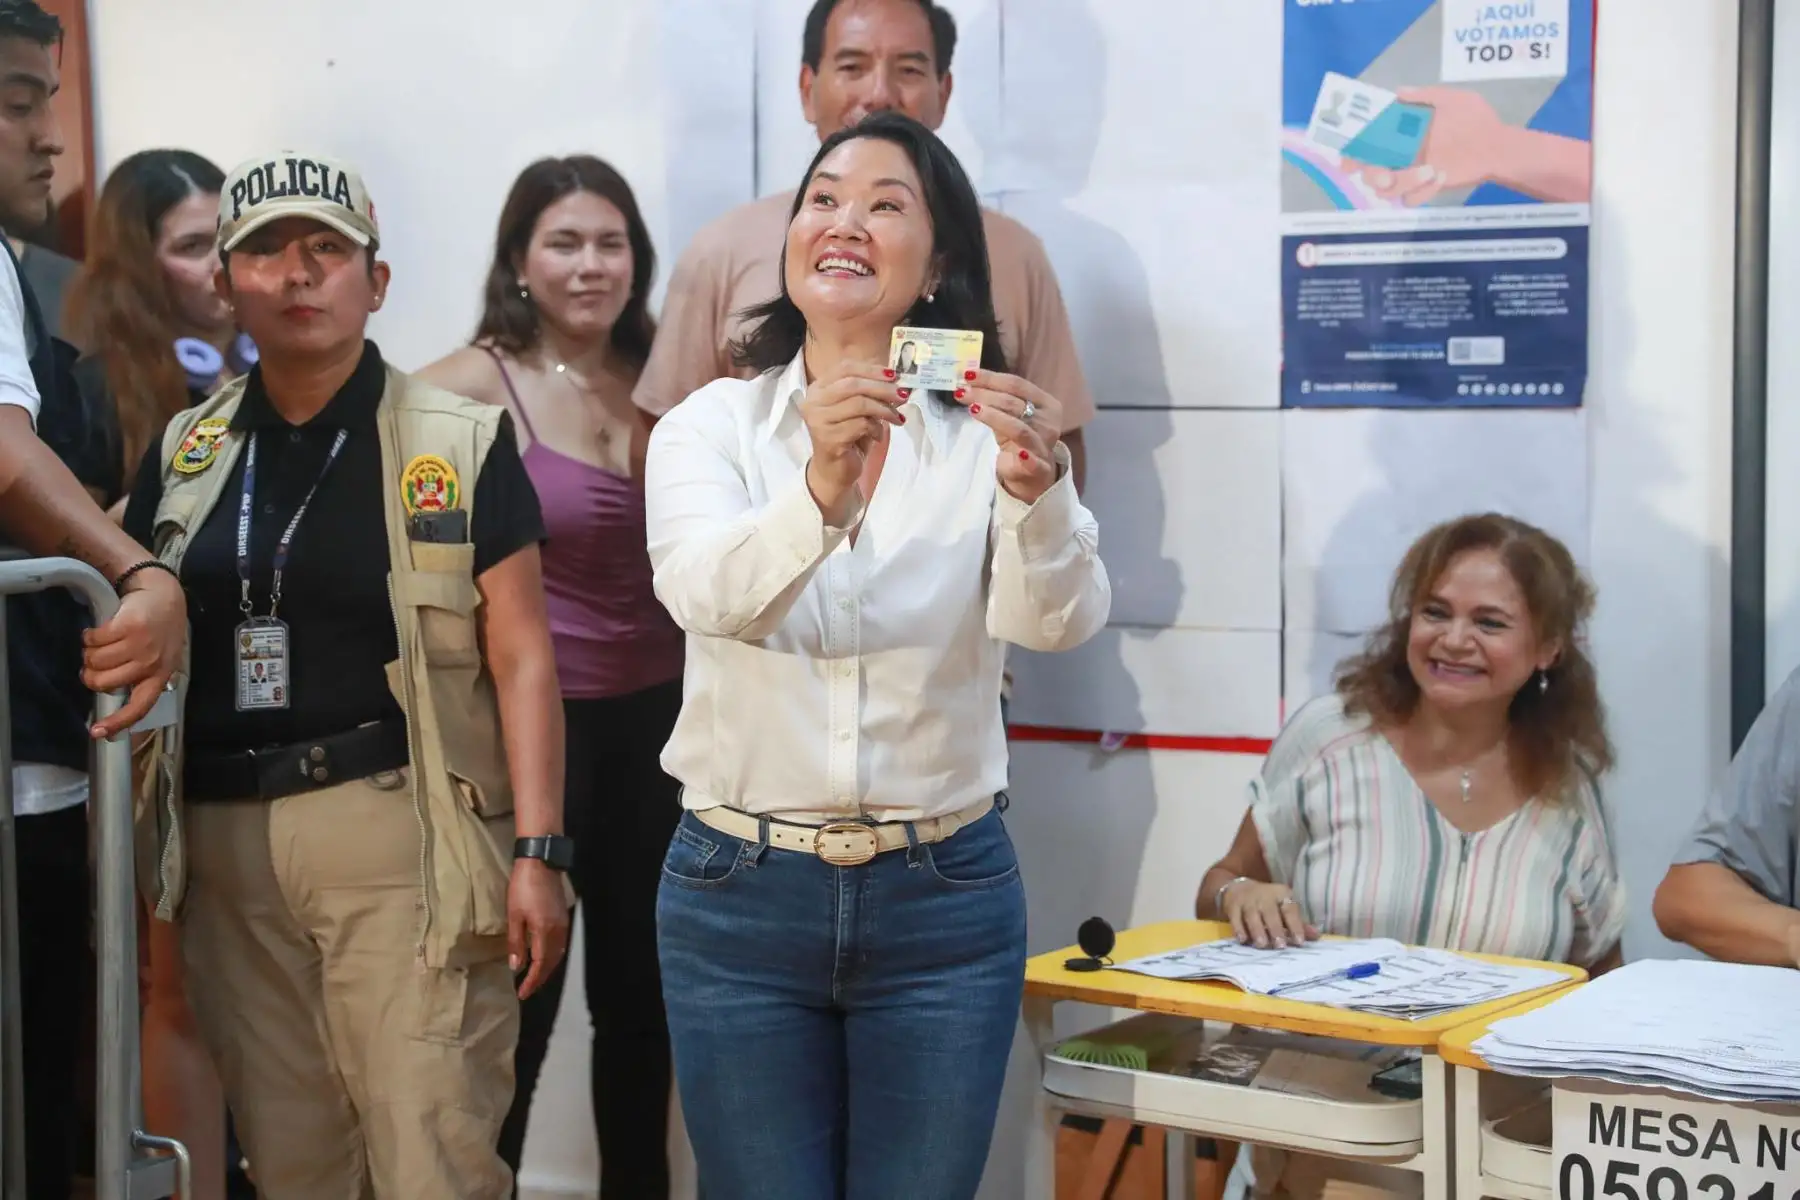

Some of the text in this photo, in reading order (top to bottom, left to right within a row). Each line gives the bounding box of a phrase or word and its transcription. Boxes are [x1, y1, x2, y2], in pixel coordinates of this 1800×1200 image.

[1455, 21, 1560, 42] VOTAMOS
[1465, 41, 1551, 63] TODS!
[230, 158, 354, 222] POLICIA
[1589, 1102, 1740, 1164] MESA
